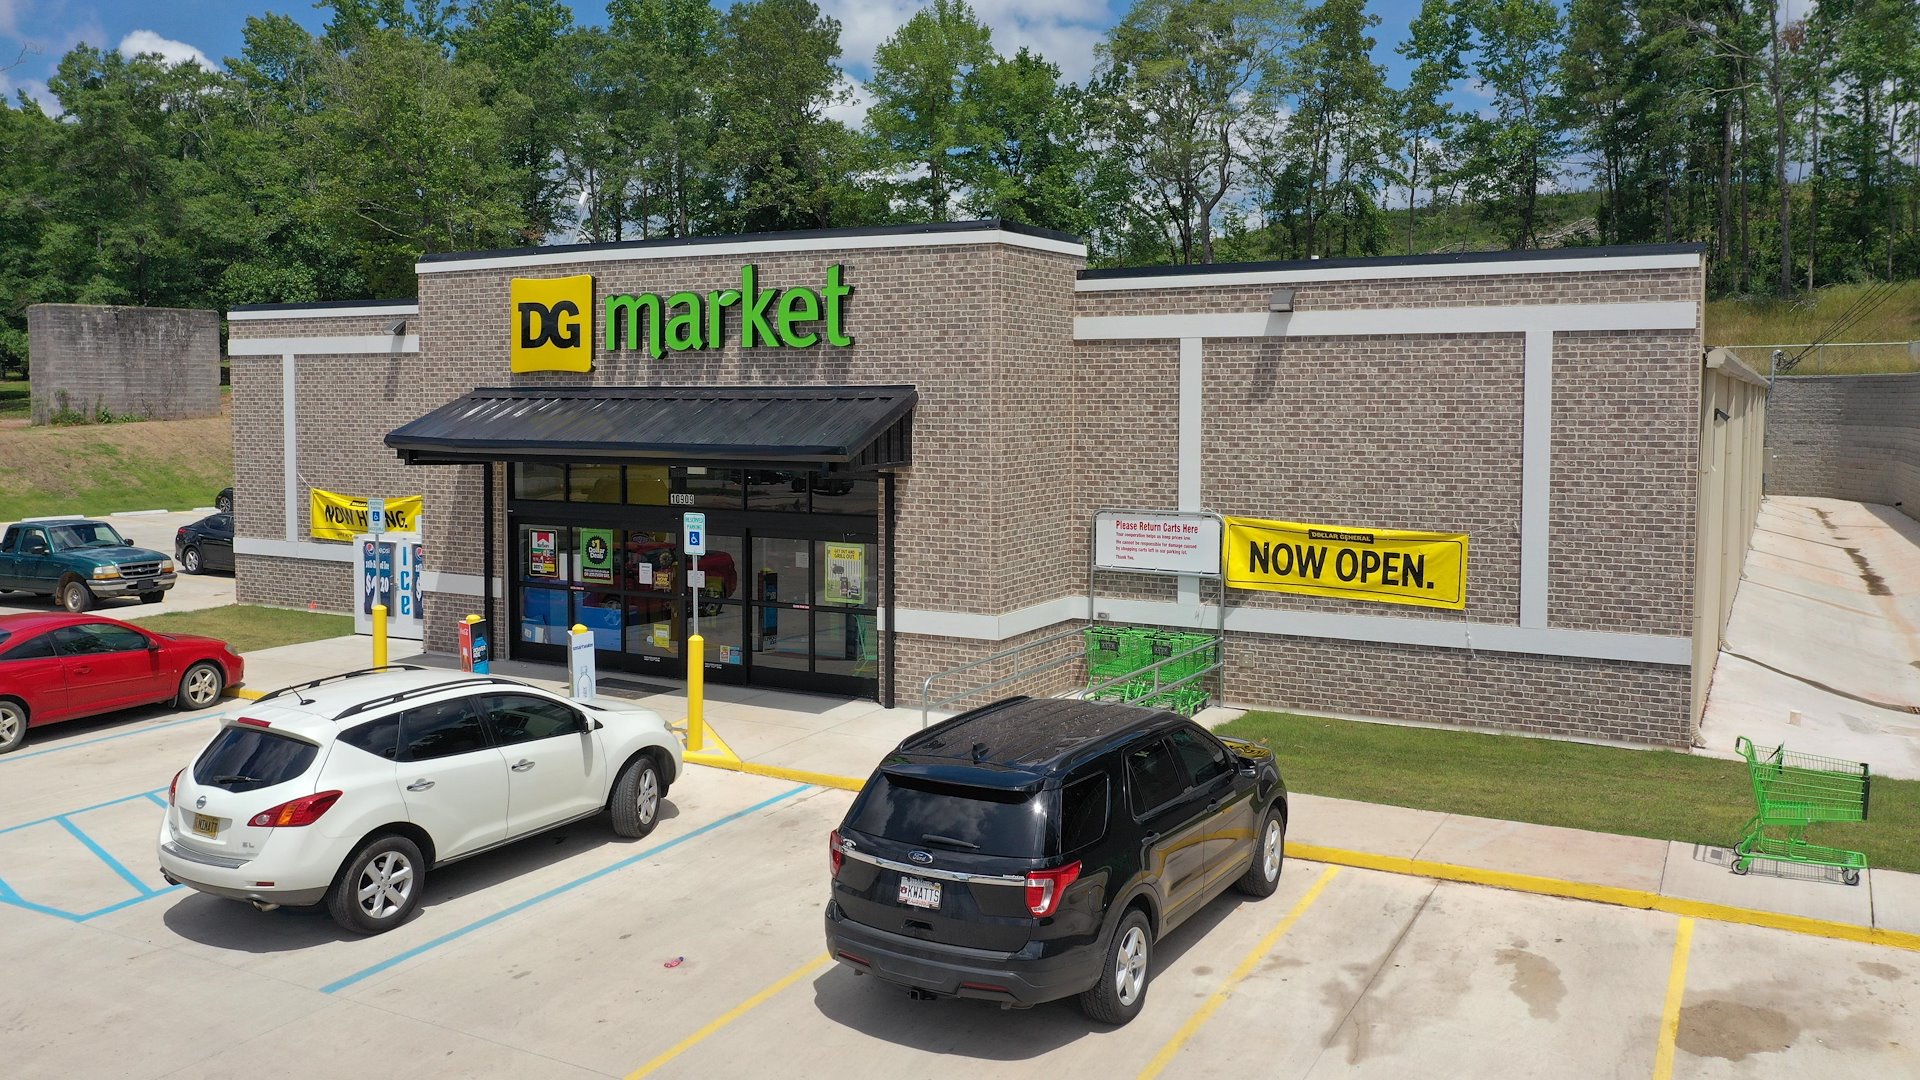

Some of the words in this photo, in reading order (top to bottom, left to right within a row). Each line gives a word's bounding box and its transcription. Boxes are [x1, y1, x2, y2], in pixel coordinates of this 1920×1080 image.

[604, 263, 855, 360] market
[517, 300, 581, 349] DG
[672, 494, 694, 504] 10909
[325, 504, 355, 525] NOW
[1116, 520, 1138, 530] Please
[1140, 522, 1162, 532] Return
[1163, 522, 1180, 532] Carts
[1182, 524, 1198, 534] Here
[1311, 531, 1338, 540] DOLLAR
[1339, 533, 1372, 542] GENERAL
[1249, 540, 1327, 580] NOW
[1335, 548, 1435, 590] OPEN.
[912, 852, 926, 862] Ford
[908, 885, 940, 902] KWATTS
